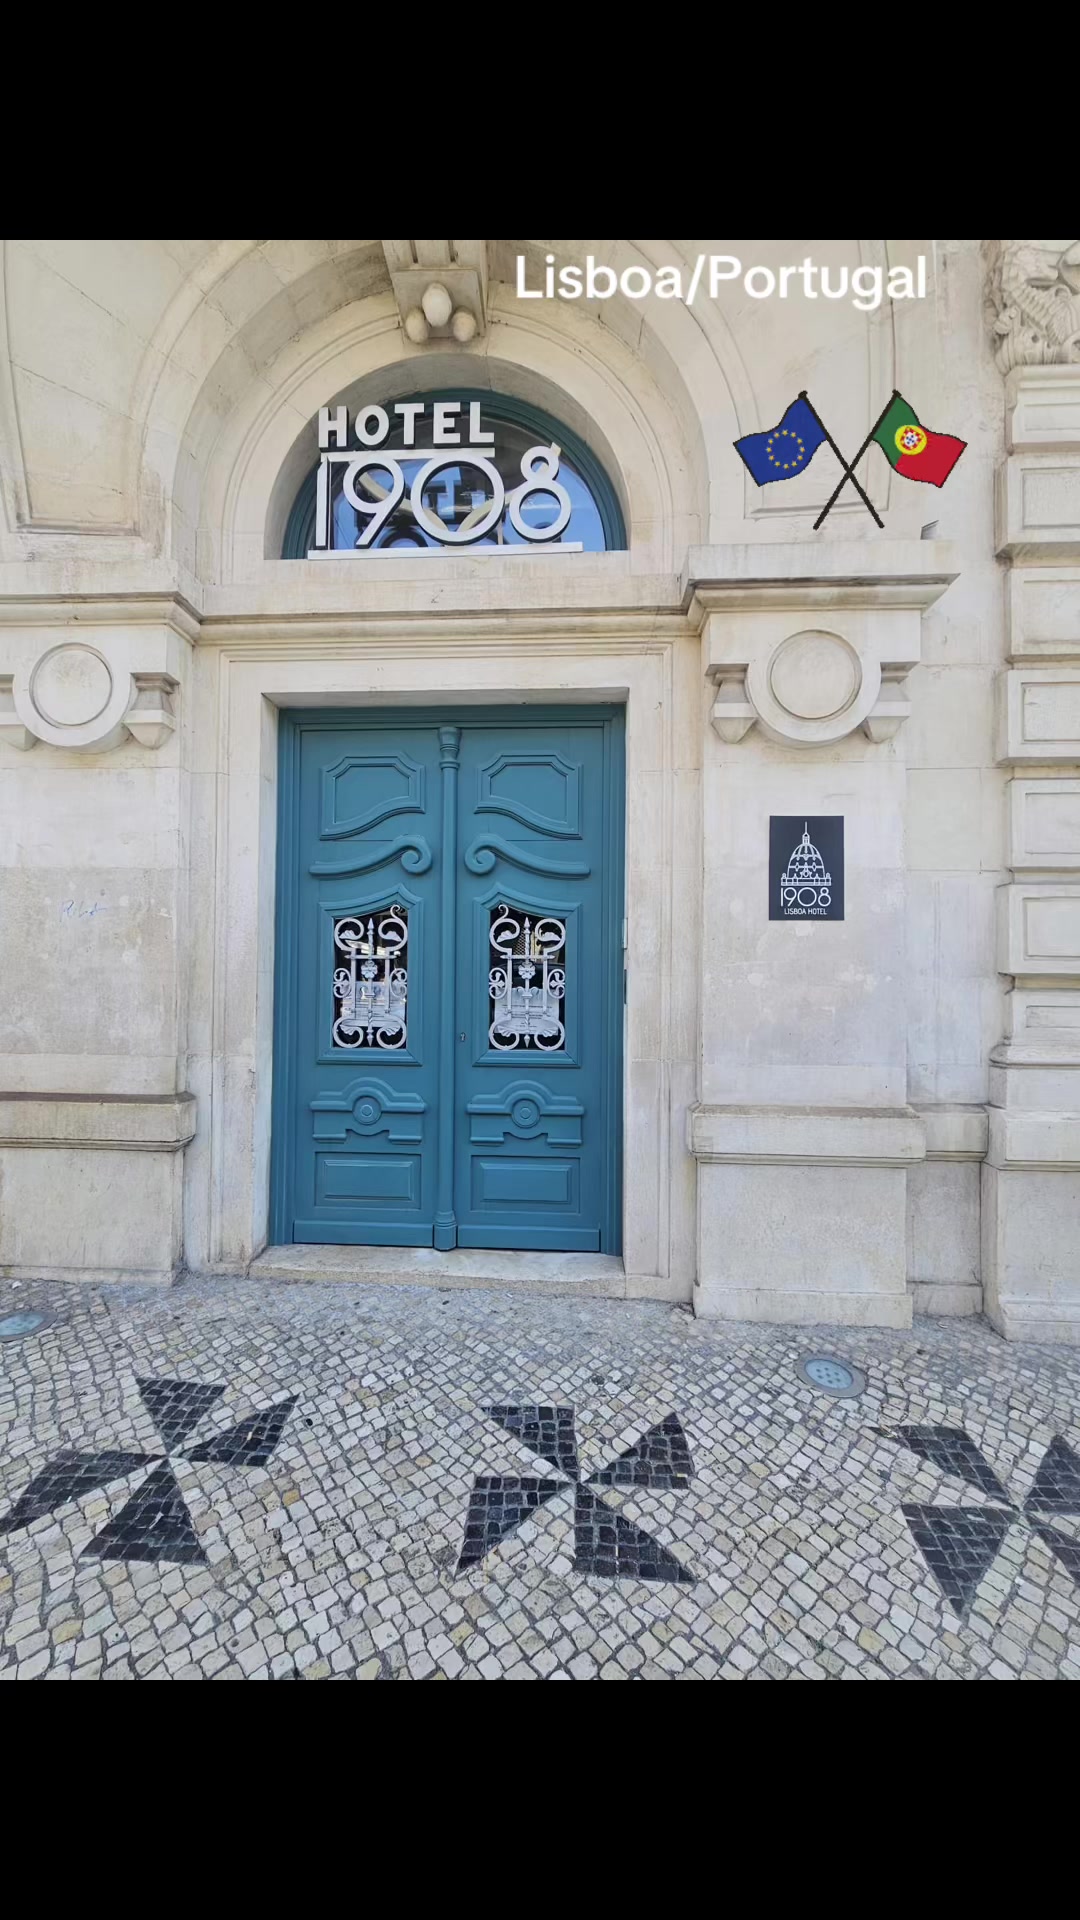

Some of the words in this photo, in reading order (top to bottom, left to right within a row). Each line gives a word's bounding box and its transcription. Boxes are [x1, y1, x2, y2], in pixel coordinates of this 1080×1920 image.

[318, 401, 495, 448] HOTEL
[315, 446, 572, 547] 1908
[780, 886, 832, 907] 1908
[784, 907, 807, 915] LISBOA
[807, 907, 828, 915] HOTEL
